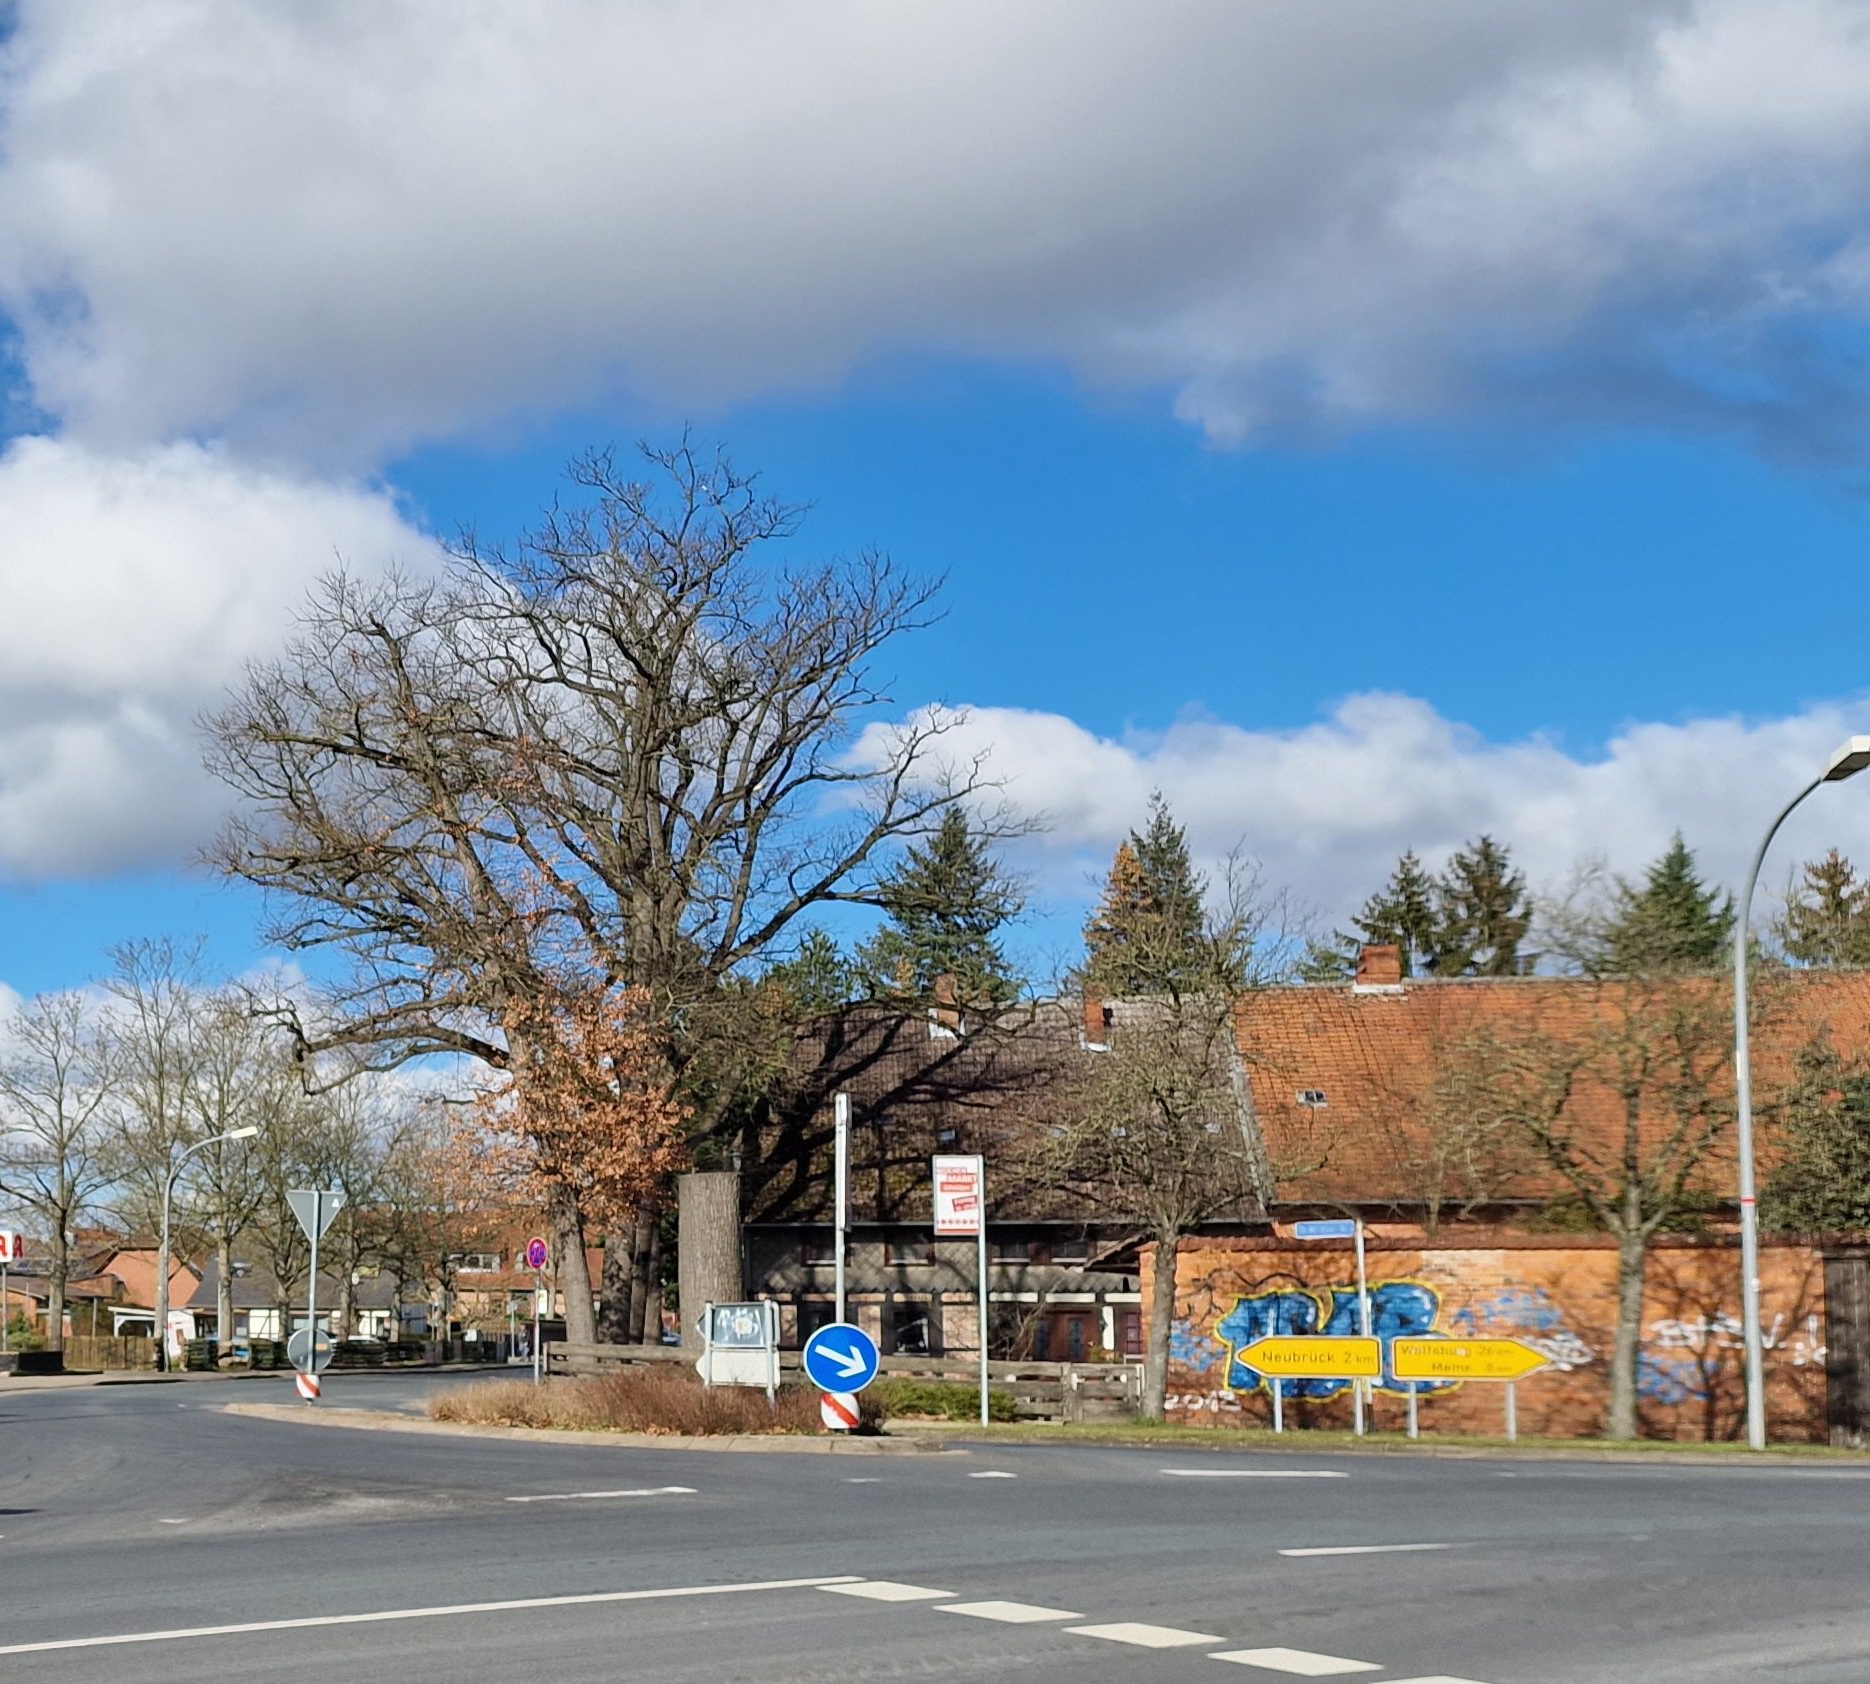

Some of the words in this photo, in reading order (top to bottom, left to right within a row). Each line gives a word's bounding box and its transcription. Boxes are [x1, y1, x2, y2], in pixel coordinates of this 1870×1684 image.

[1262, 1351, 1335, 1363] Neubrück
[1344, 1352, 1352, 1363] 2
[1356, 1354, 1374, 1363] km
[1401, 1345, 1471, 1357] Wolfsbug
